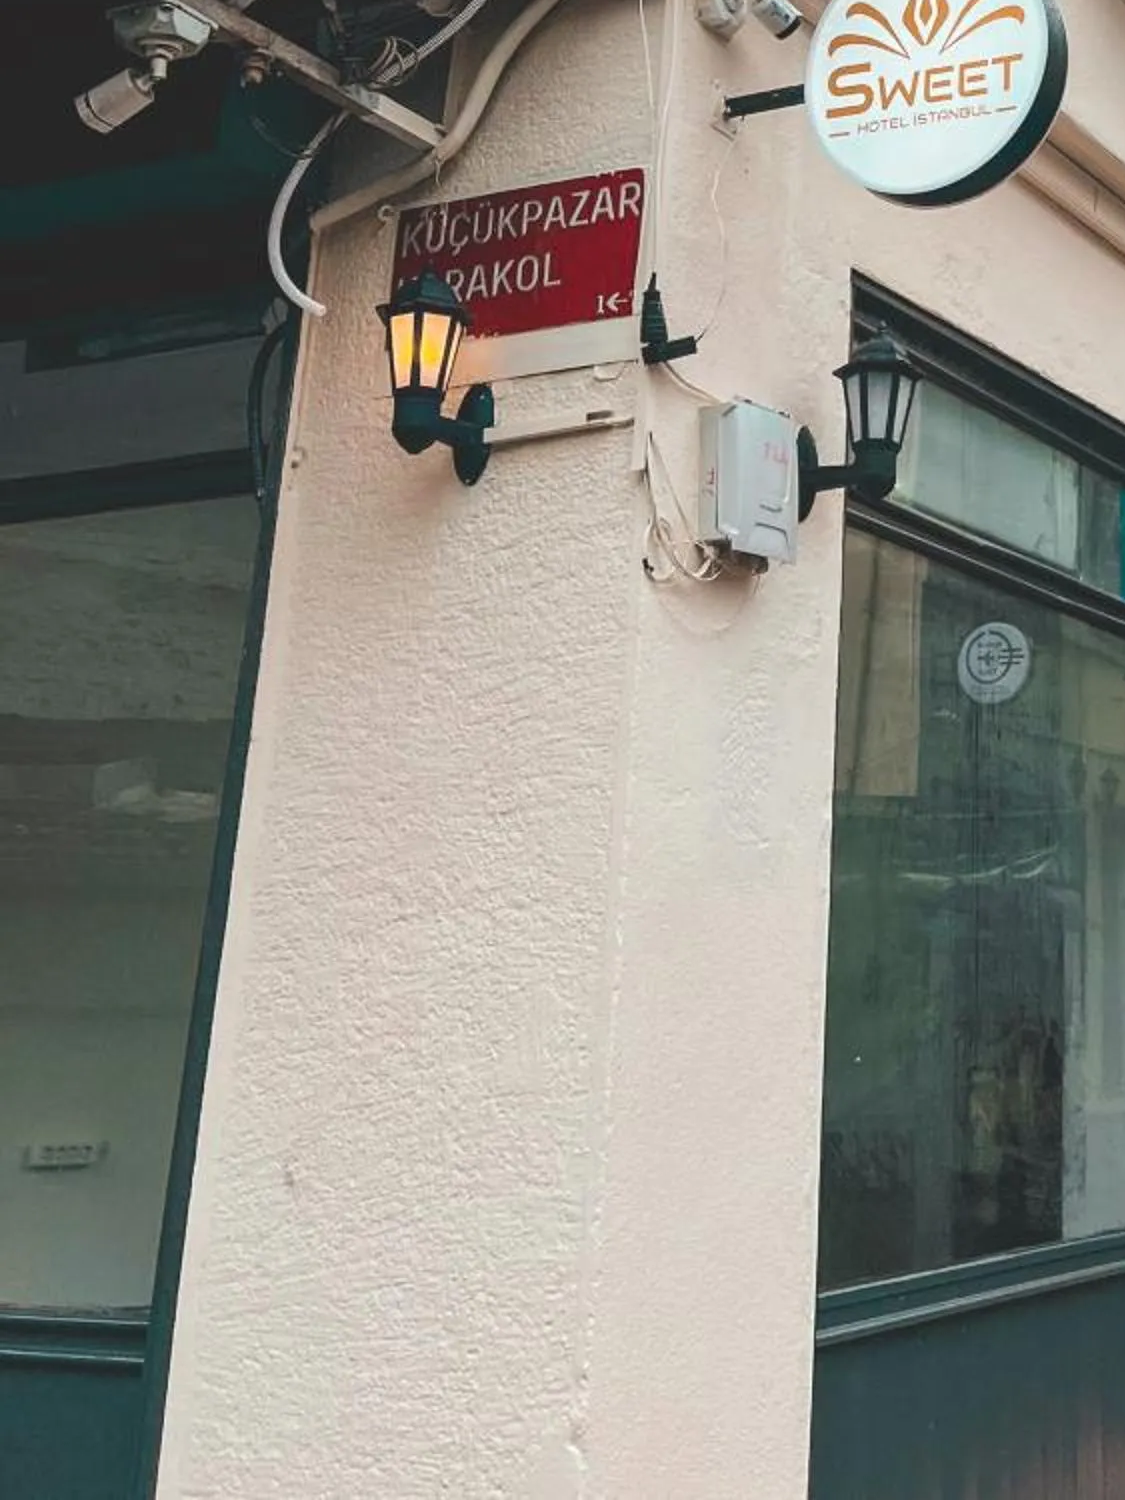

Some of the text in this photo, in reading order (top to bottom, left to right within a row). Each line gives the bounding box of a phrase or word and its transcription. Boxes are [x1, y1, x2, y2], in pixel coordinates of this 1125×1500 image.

[826, 54, 1023, 119] SWEET
[857, 116, 910, 135] HOTEL
[401, 181, 642, 258] KÜÇÜKPAZAR
[398, 251, 562, 303] RAKOL
